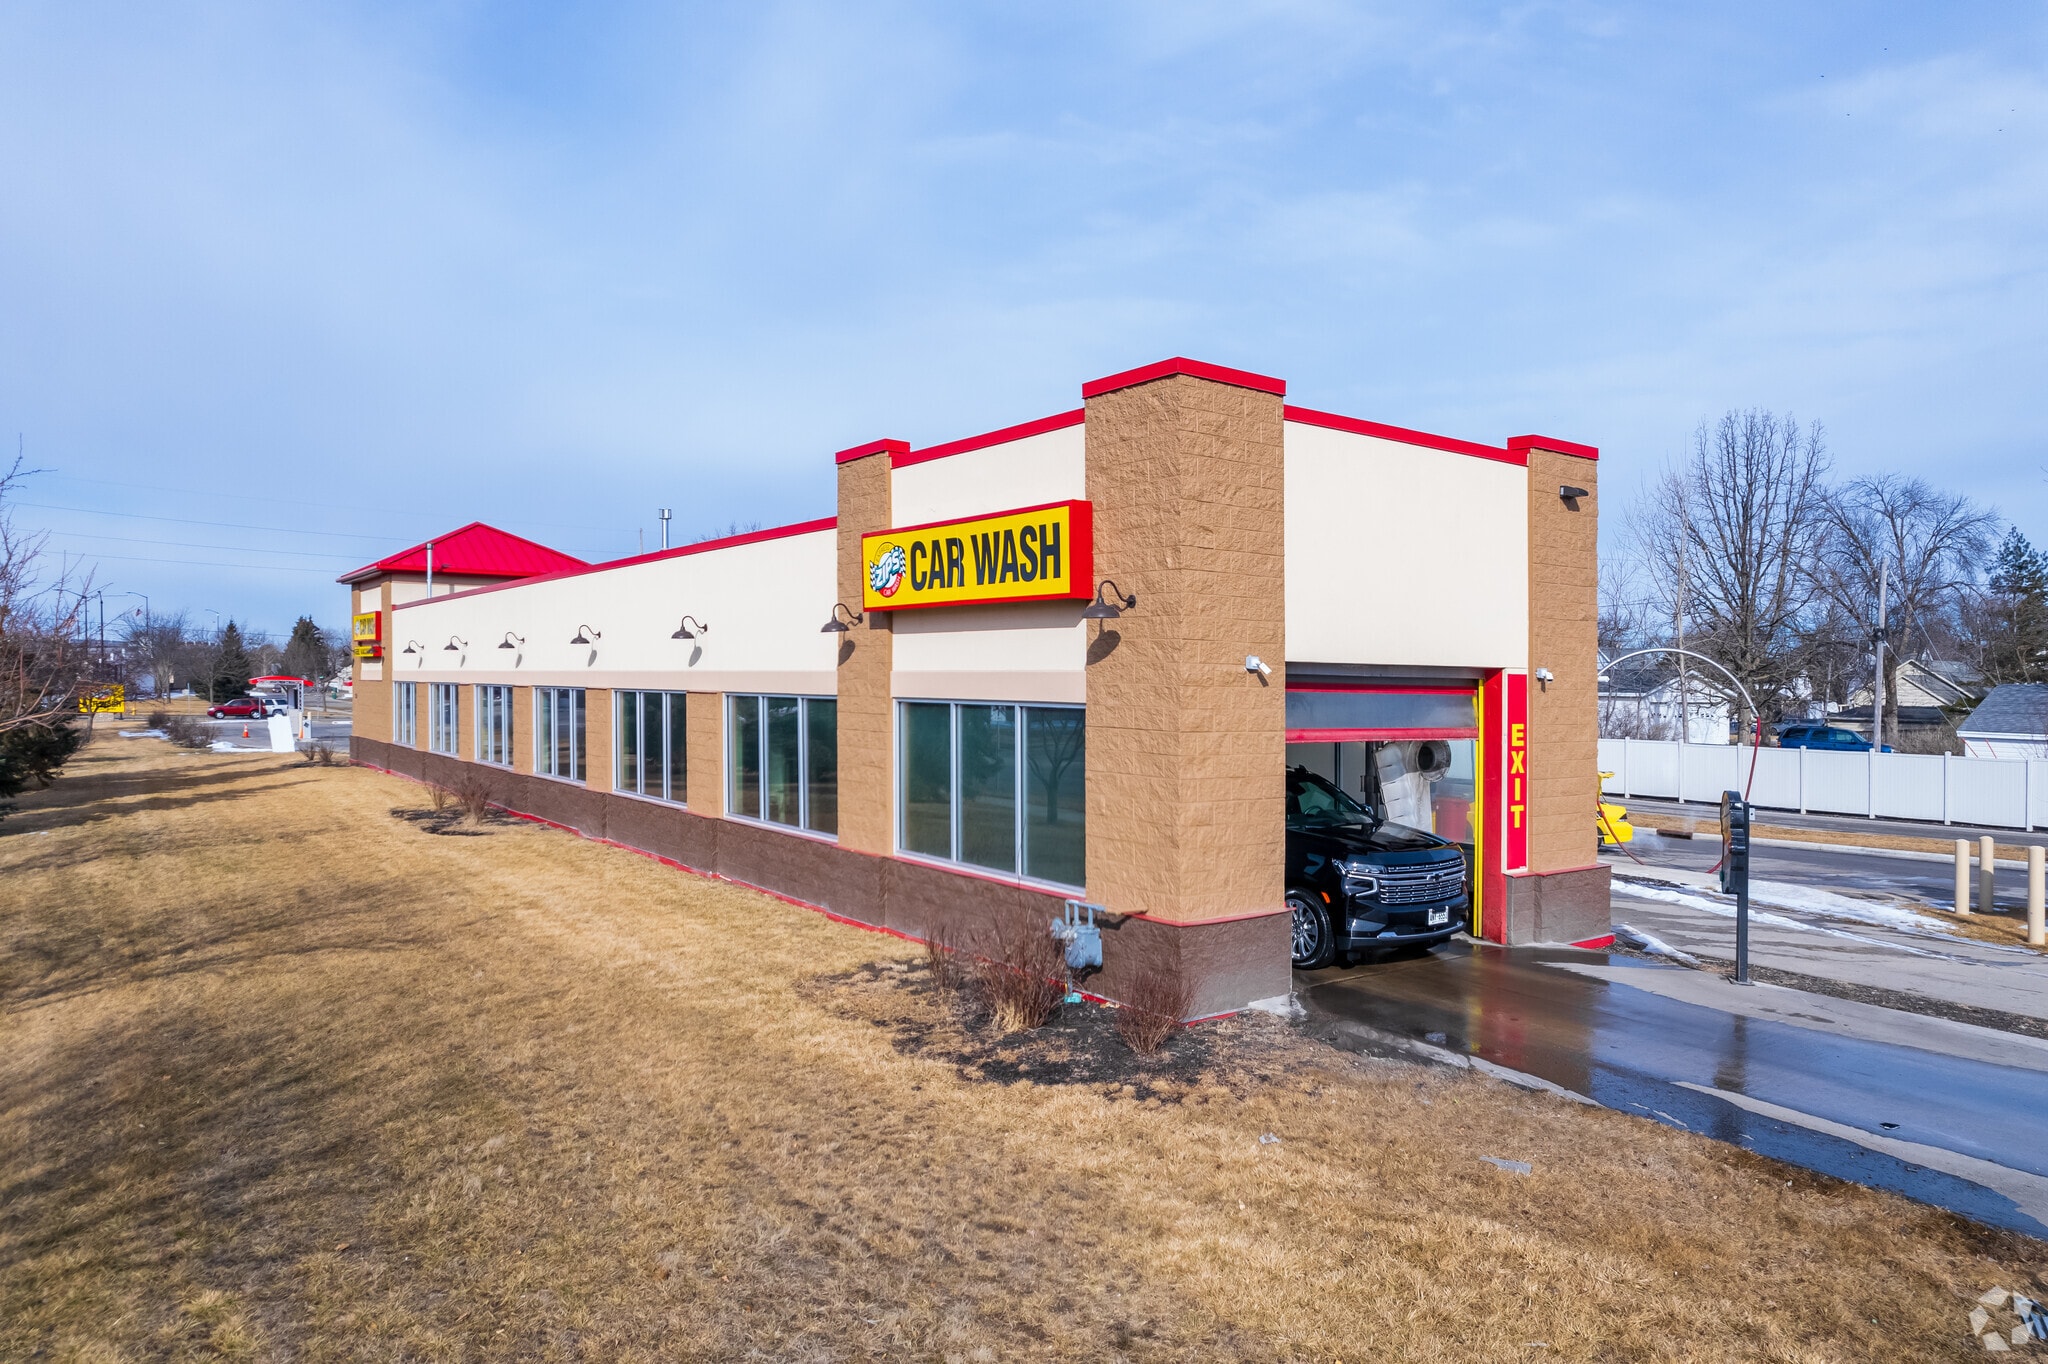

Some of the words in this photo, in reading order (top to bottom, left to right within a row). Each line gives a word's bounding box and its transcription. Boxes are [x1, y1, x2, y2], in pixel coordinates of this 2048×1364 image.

[874, 550, 900, 588] ZIPS
[911, 537, 965, 591] CAR
[971, 522, 1060, 586] WASH
[1511, 723, 1525, 828] EXIT
